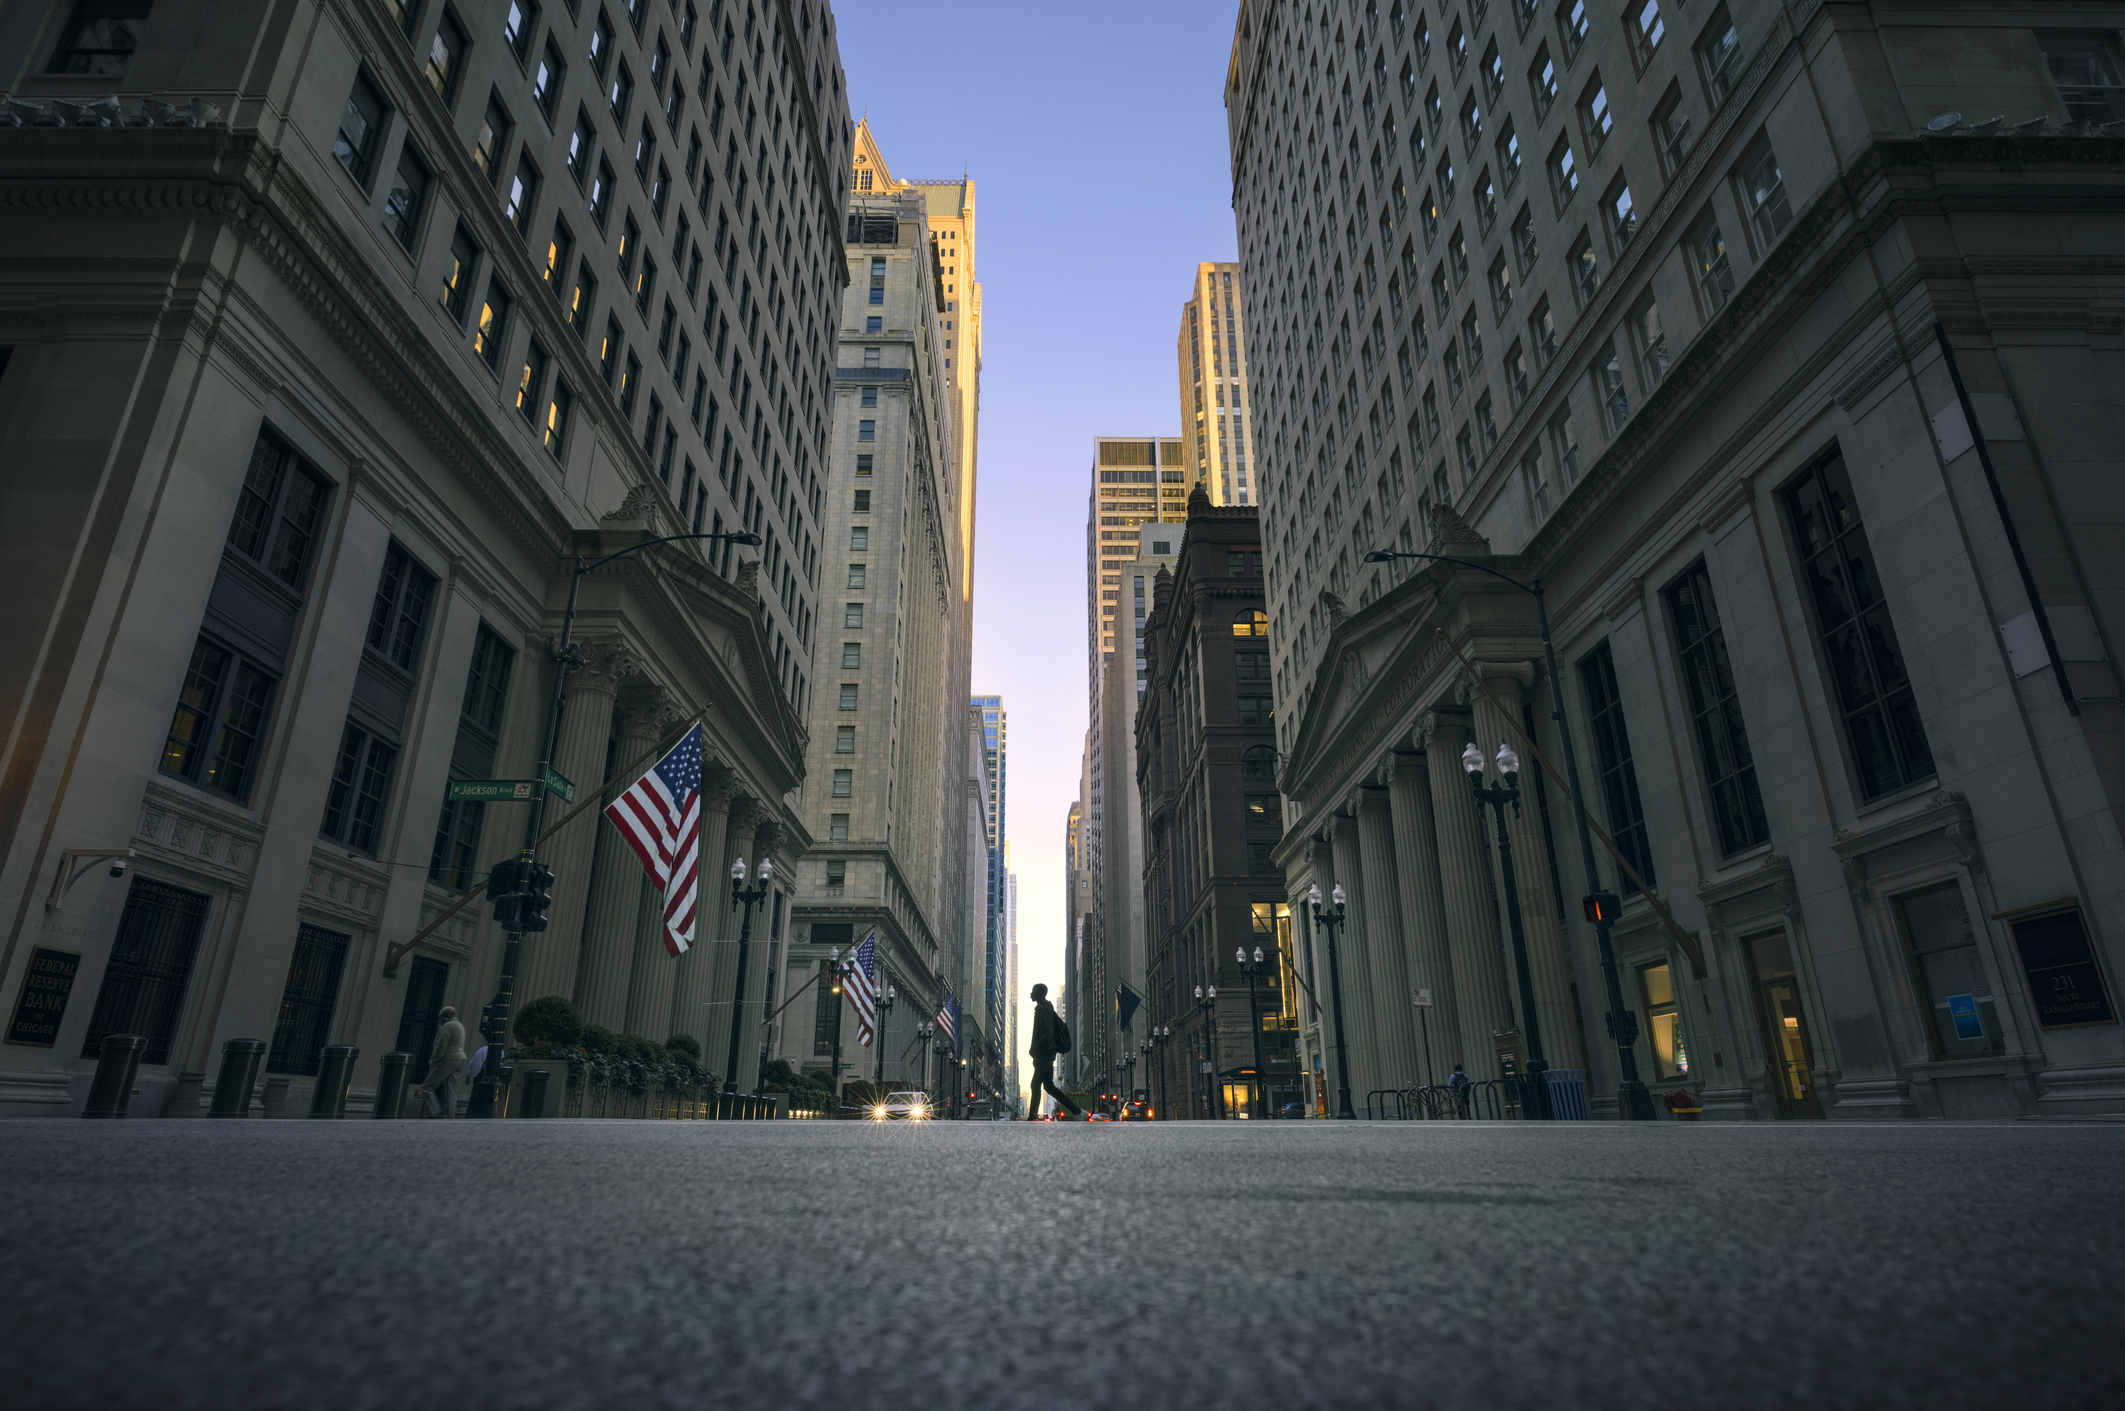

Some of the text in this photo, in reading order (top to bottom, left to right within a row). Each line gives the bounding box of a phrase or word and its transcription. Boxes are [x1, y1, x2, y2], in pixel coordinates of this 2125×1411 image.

[1340, 715, 1380, 770] FINANCIAL
[460, 784, 498, 795] Jackson
[34, 920, 94, 939] LA SALLE ST
[33, 957, 75, 976] FEDERAL
[28, 974, 71, 993] RESERVE
[2051, 974, 2075, 991] 231
[25, 992, 65, 1011] BANK
[2056, 992, 2081, 1002] SOUTH
[2074, 1001, 2101, 1011] STREET
[36, 1013, 45, 1021] OF
[16, 1022, 55, 1035] CHICAGO
